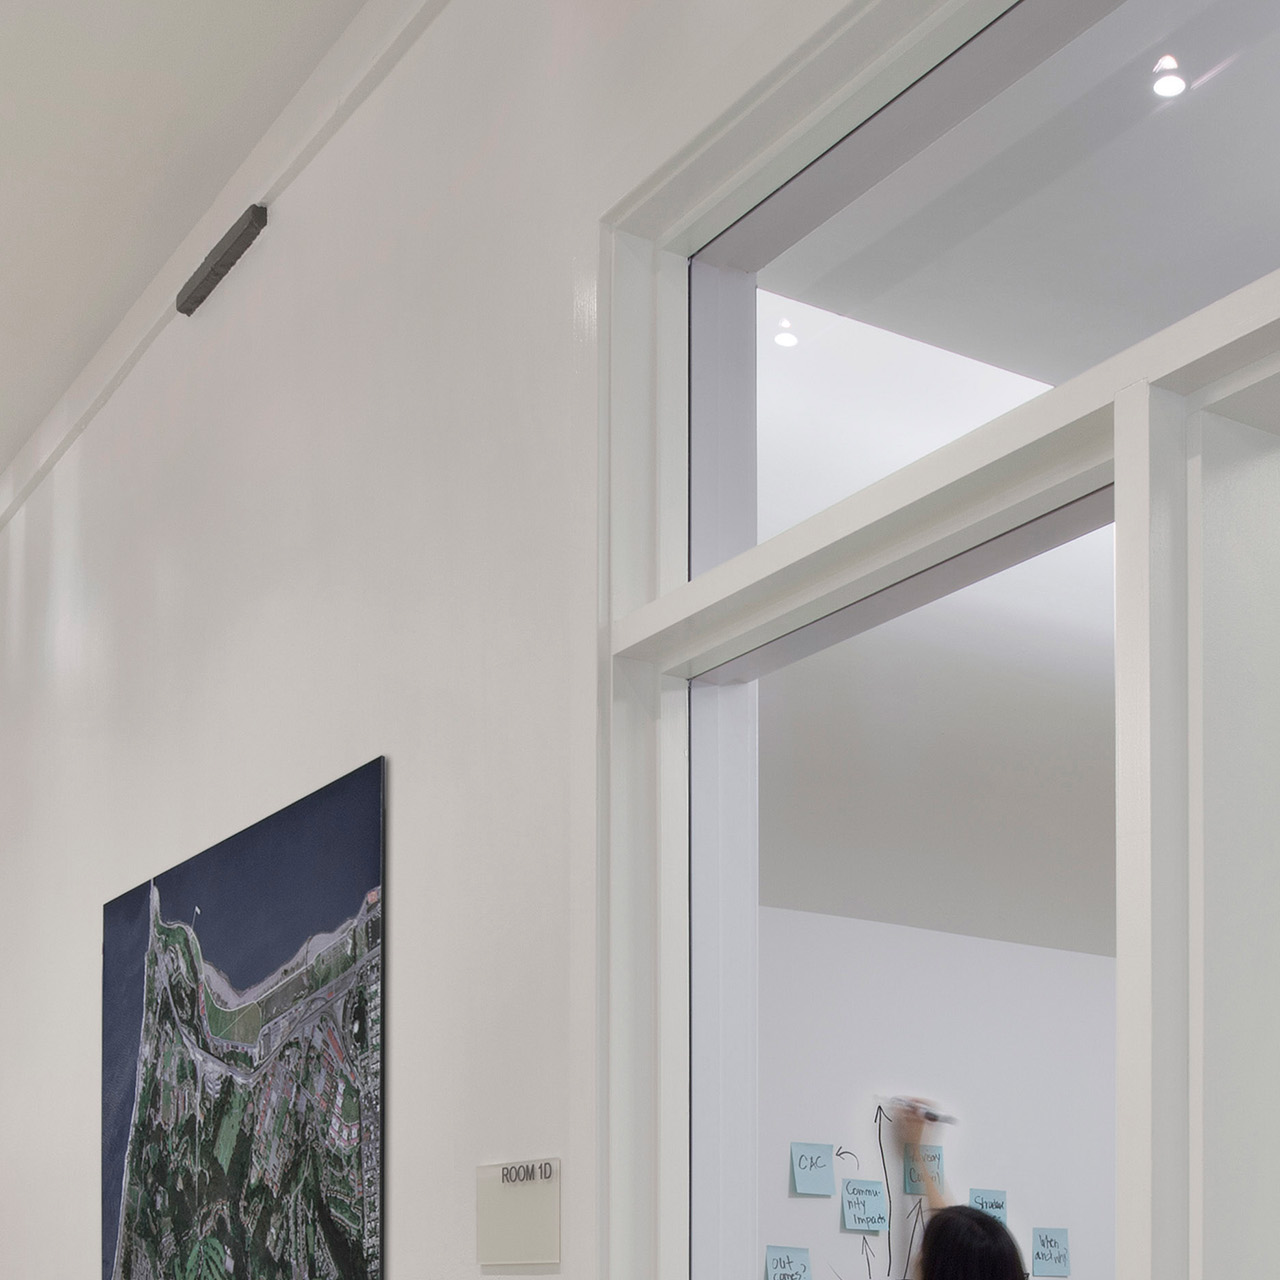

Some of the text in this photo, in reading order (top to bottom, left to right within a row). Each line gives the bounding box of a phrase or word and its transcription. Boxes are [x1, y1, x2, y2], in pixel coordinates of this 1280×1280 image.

[501, 1162, 553, 1184] ROOM 1D
[847, 1197, 867, 1215] nity
[1034, 1249, 1053, 1262] and
